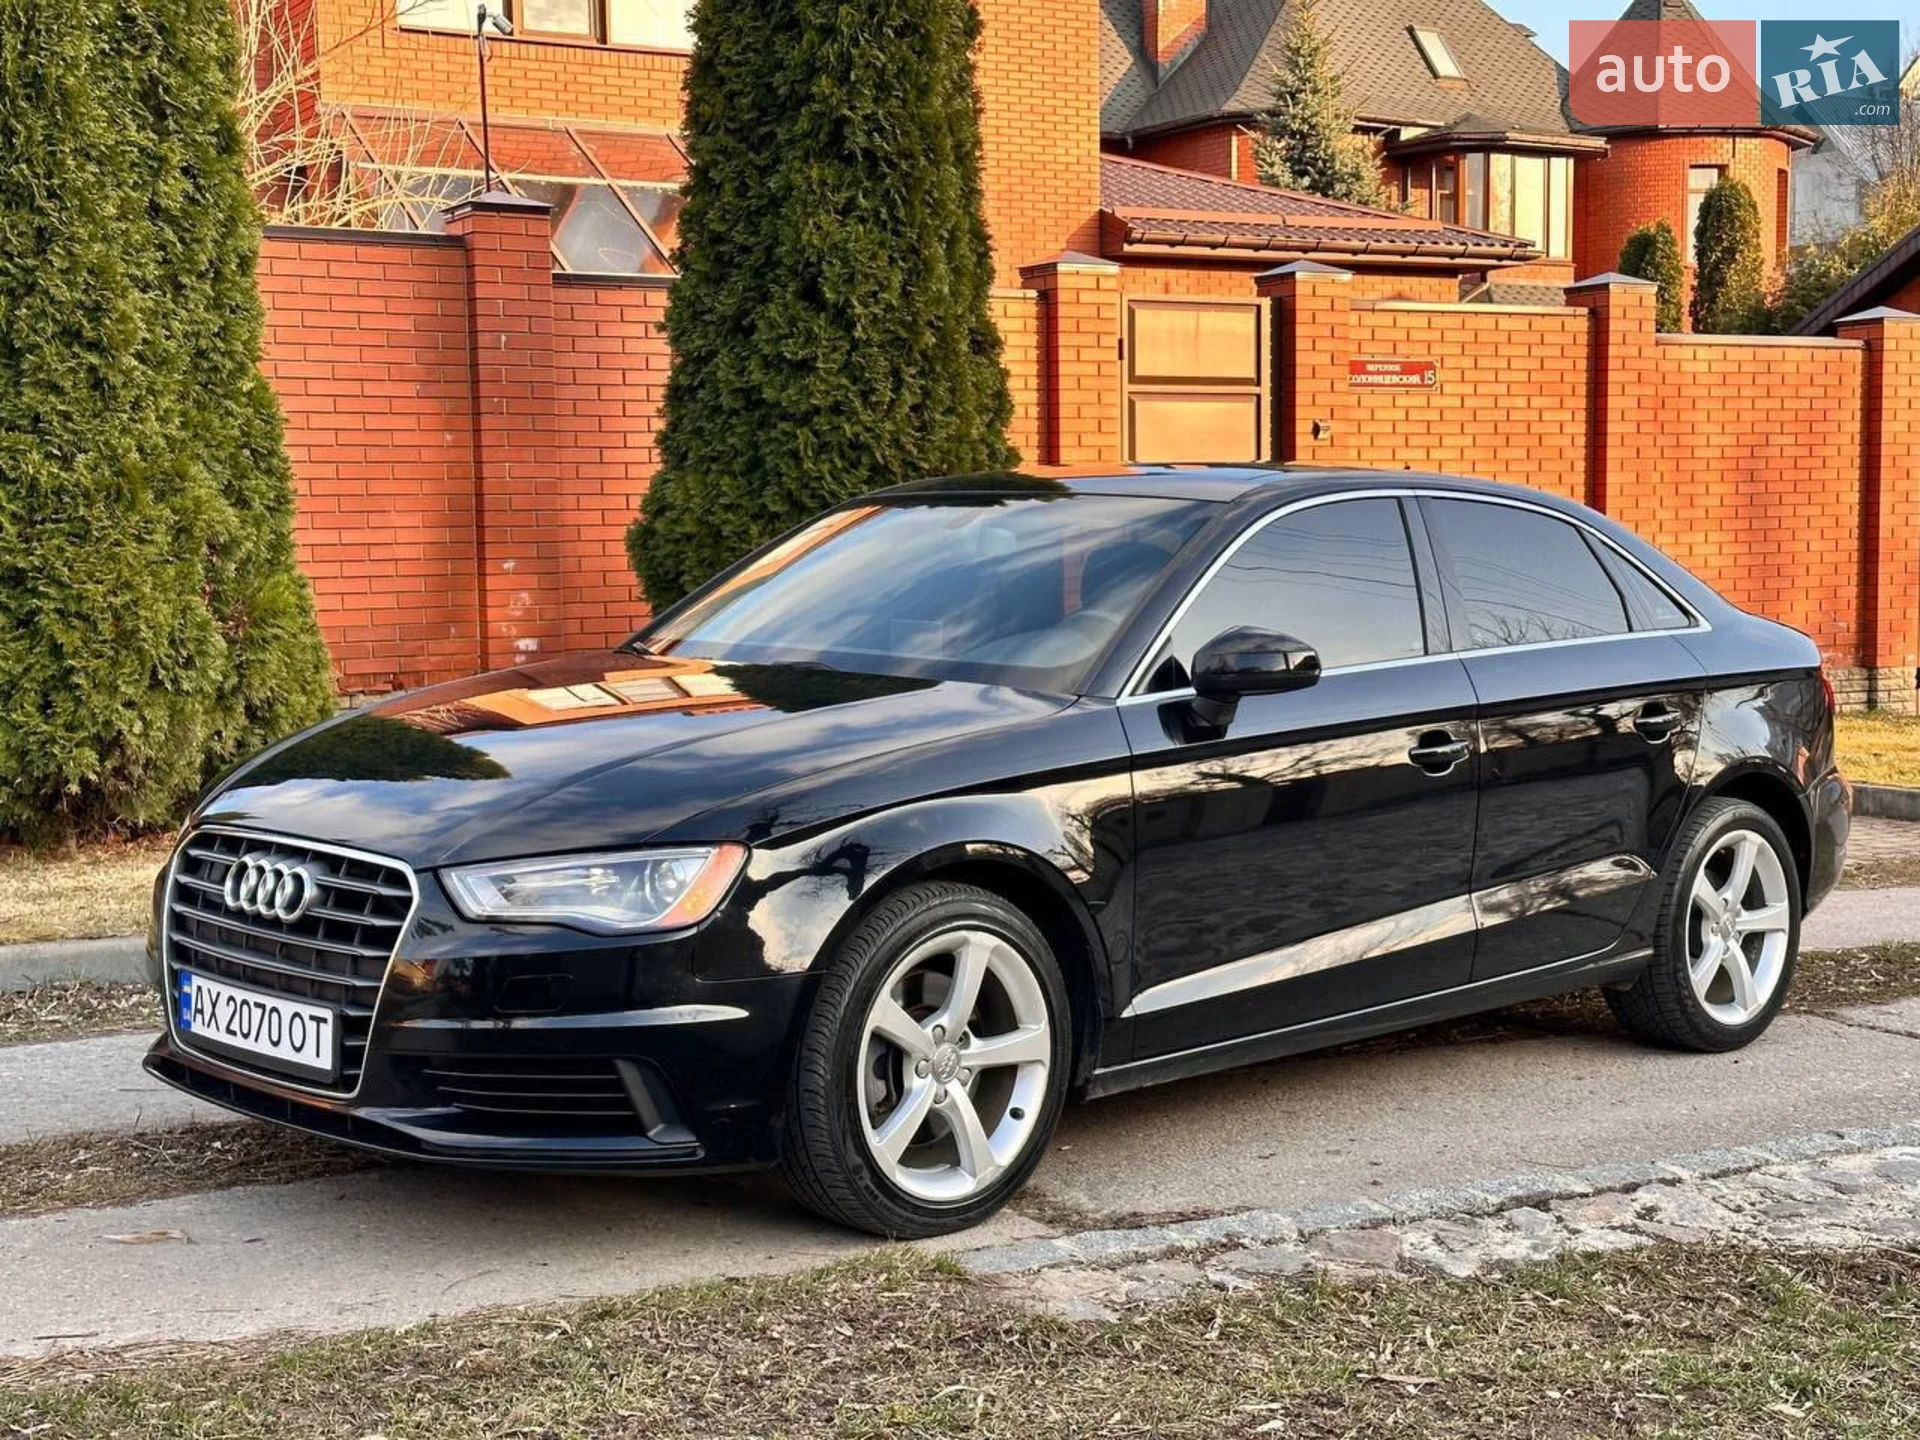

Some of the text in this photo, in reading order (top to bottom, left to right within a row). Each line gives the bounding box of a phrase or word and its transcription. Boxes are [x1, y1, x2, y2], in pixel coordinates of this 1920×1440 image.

[1424, 370, 1435, 385] 15
[193, 985, 328, 1058] AX 2070 OT
